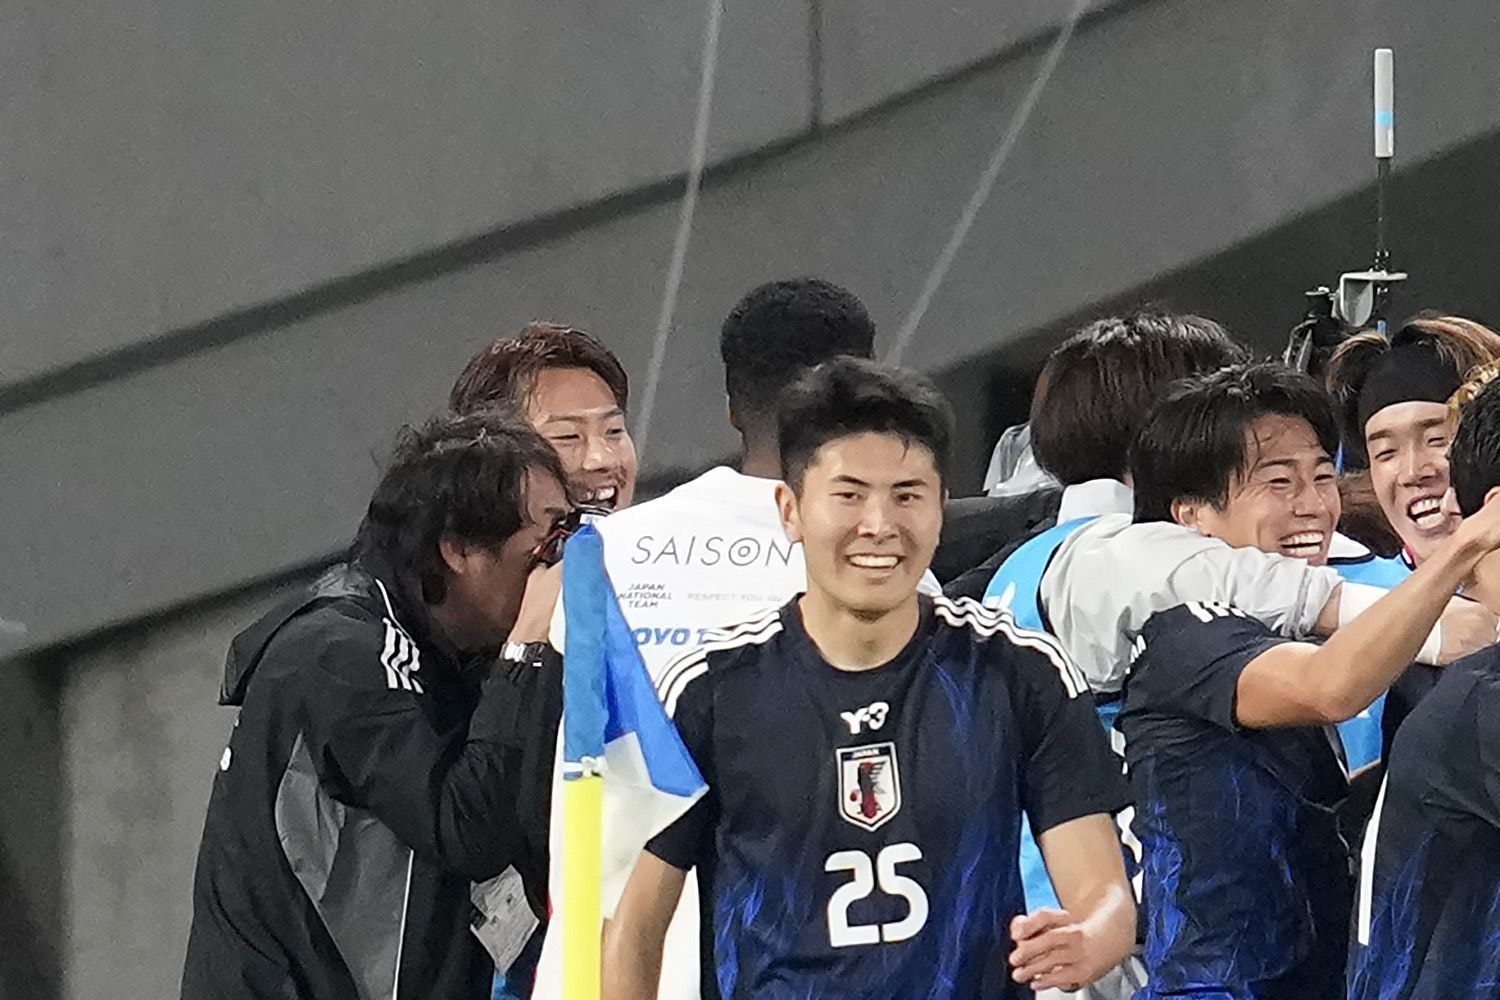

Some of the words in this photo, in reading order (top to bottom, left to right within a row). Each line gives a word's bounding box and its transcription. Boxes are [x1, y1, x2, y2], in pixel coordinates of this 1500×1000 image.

[631, 536, 793, 567] SAISON
[634, 627, 691, 646] OYO
[840, 702, 889, 734] Y-3
[824, 842, 930, 948] 25
